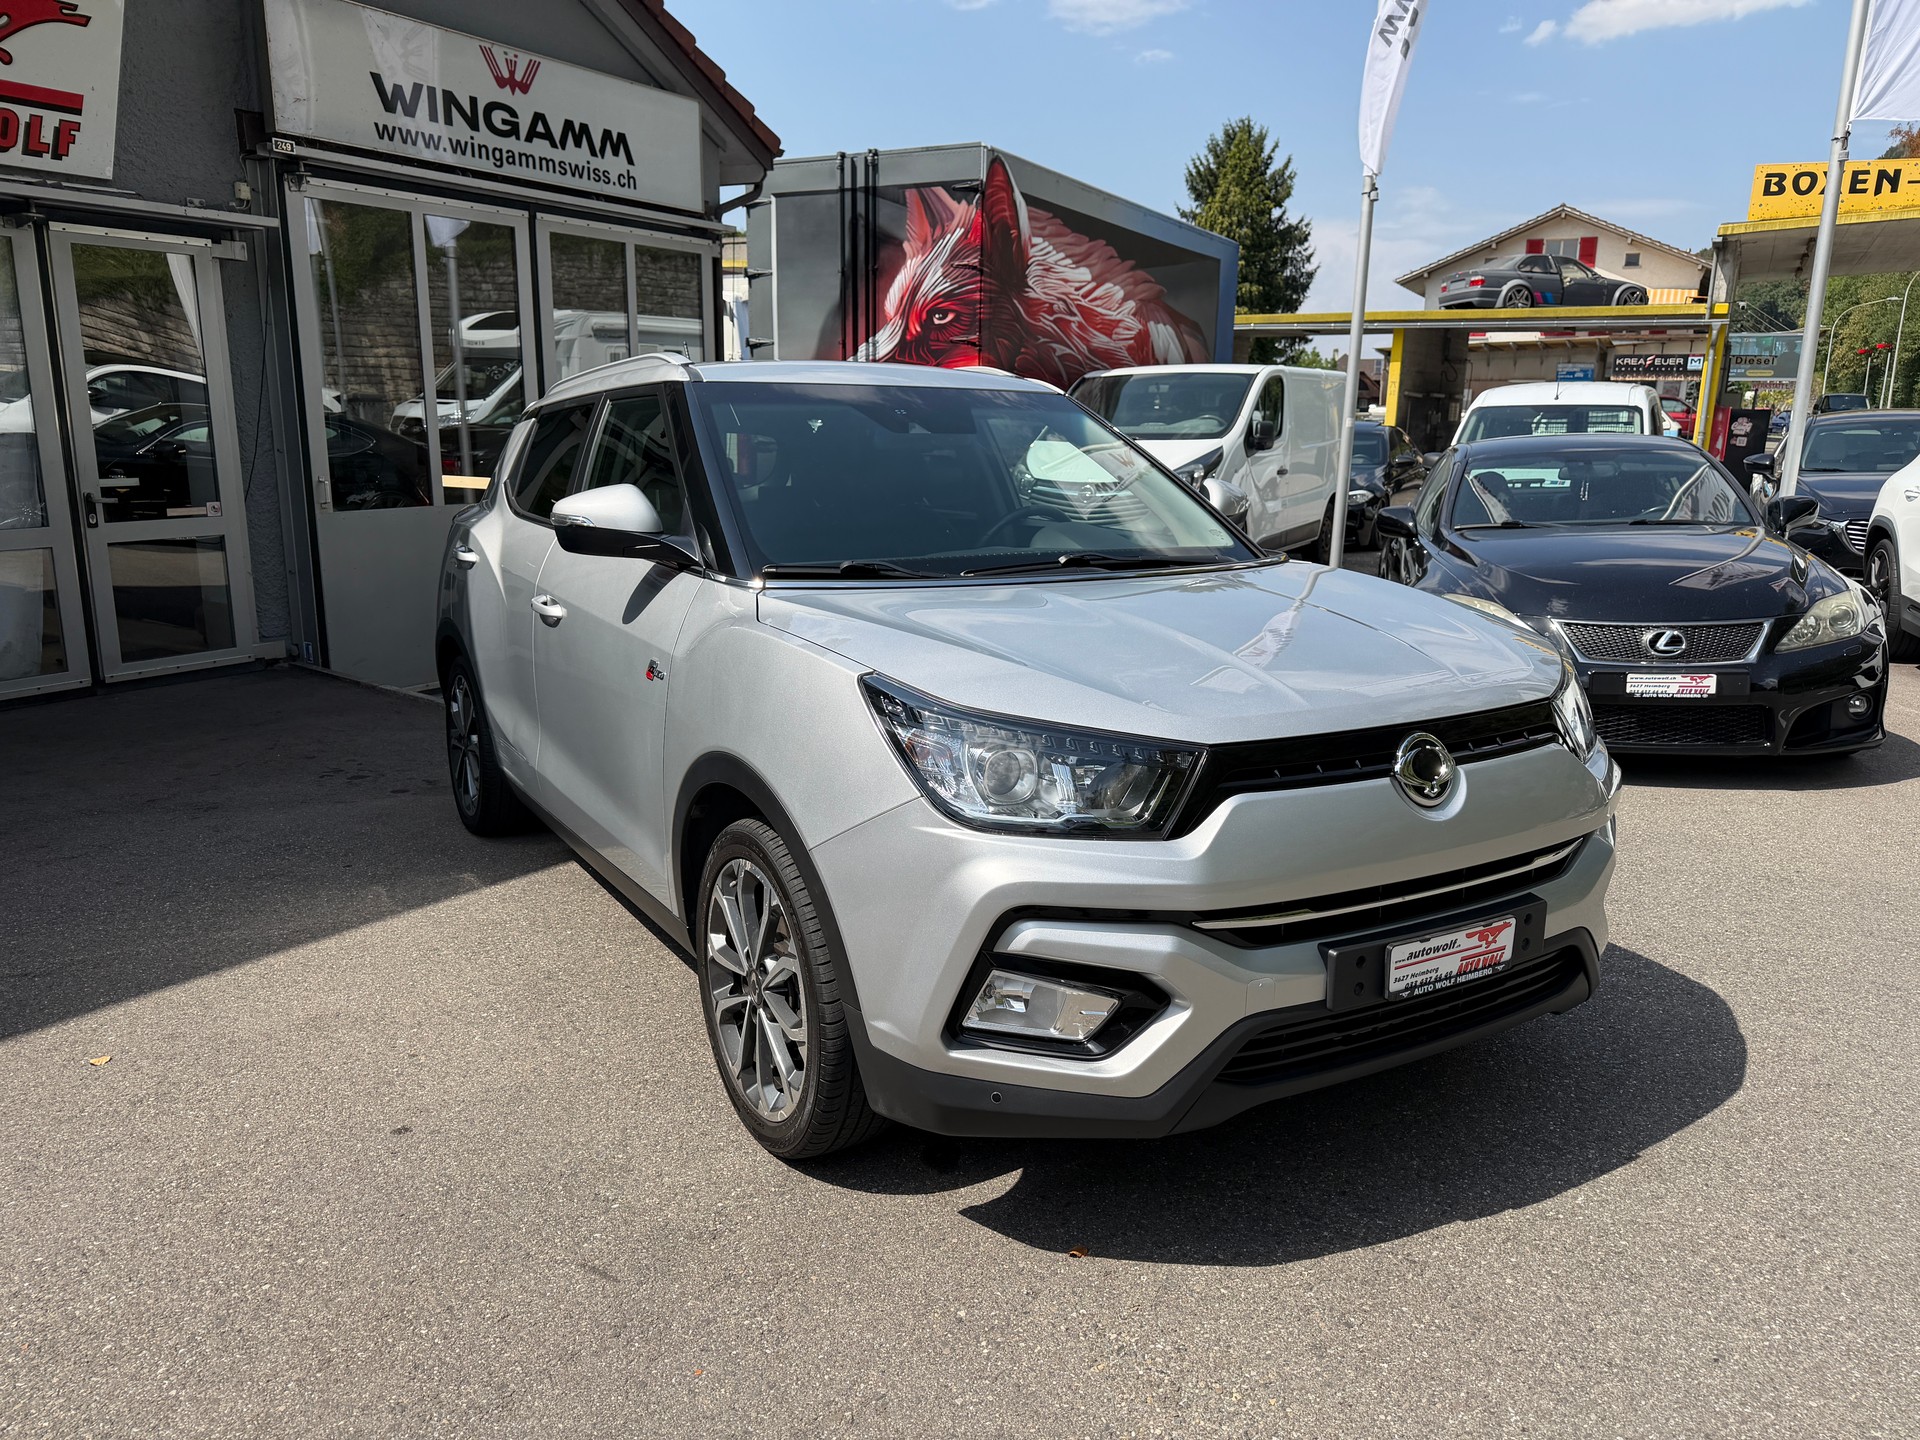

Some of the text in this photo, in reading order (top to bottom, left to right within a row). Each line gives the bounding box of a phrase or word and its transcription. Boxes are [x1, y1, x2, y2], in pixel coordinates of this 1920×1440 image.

[369, 71, 635, 167] WINGAMM
[277, 141, 292, 151] 249
[374, 121, 638, 190] www.wingammswiss.ch
[1735, 355, 1776, 365] Diesel
[1482, 952, 1505, 969] WOLF
[1393, 967, 1440, 984] 3627 Heimberg
[1414, 967, 1493, 996] AUTO WOLF HEIMBERG
